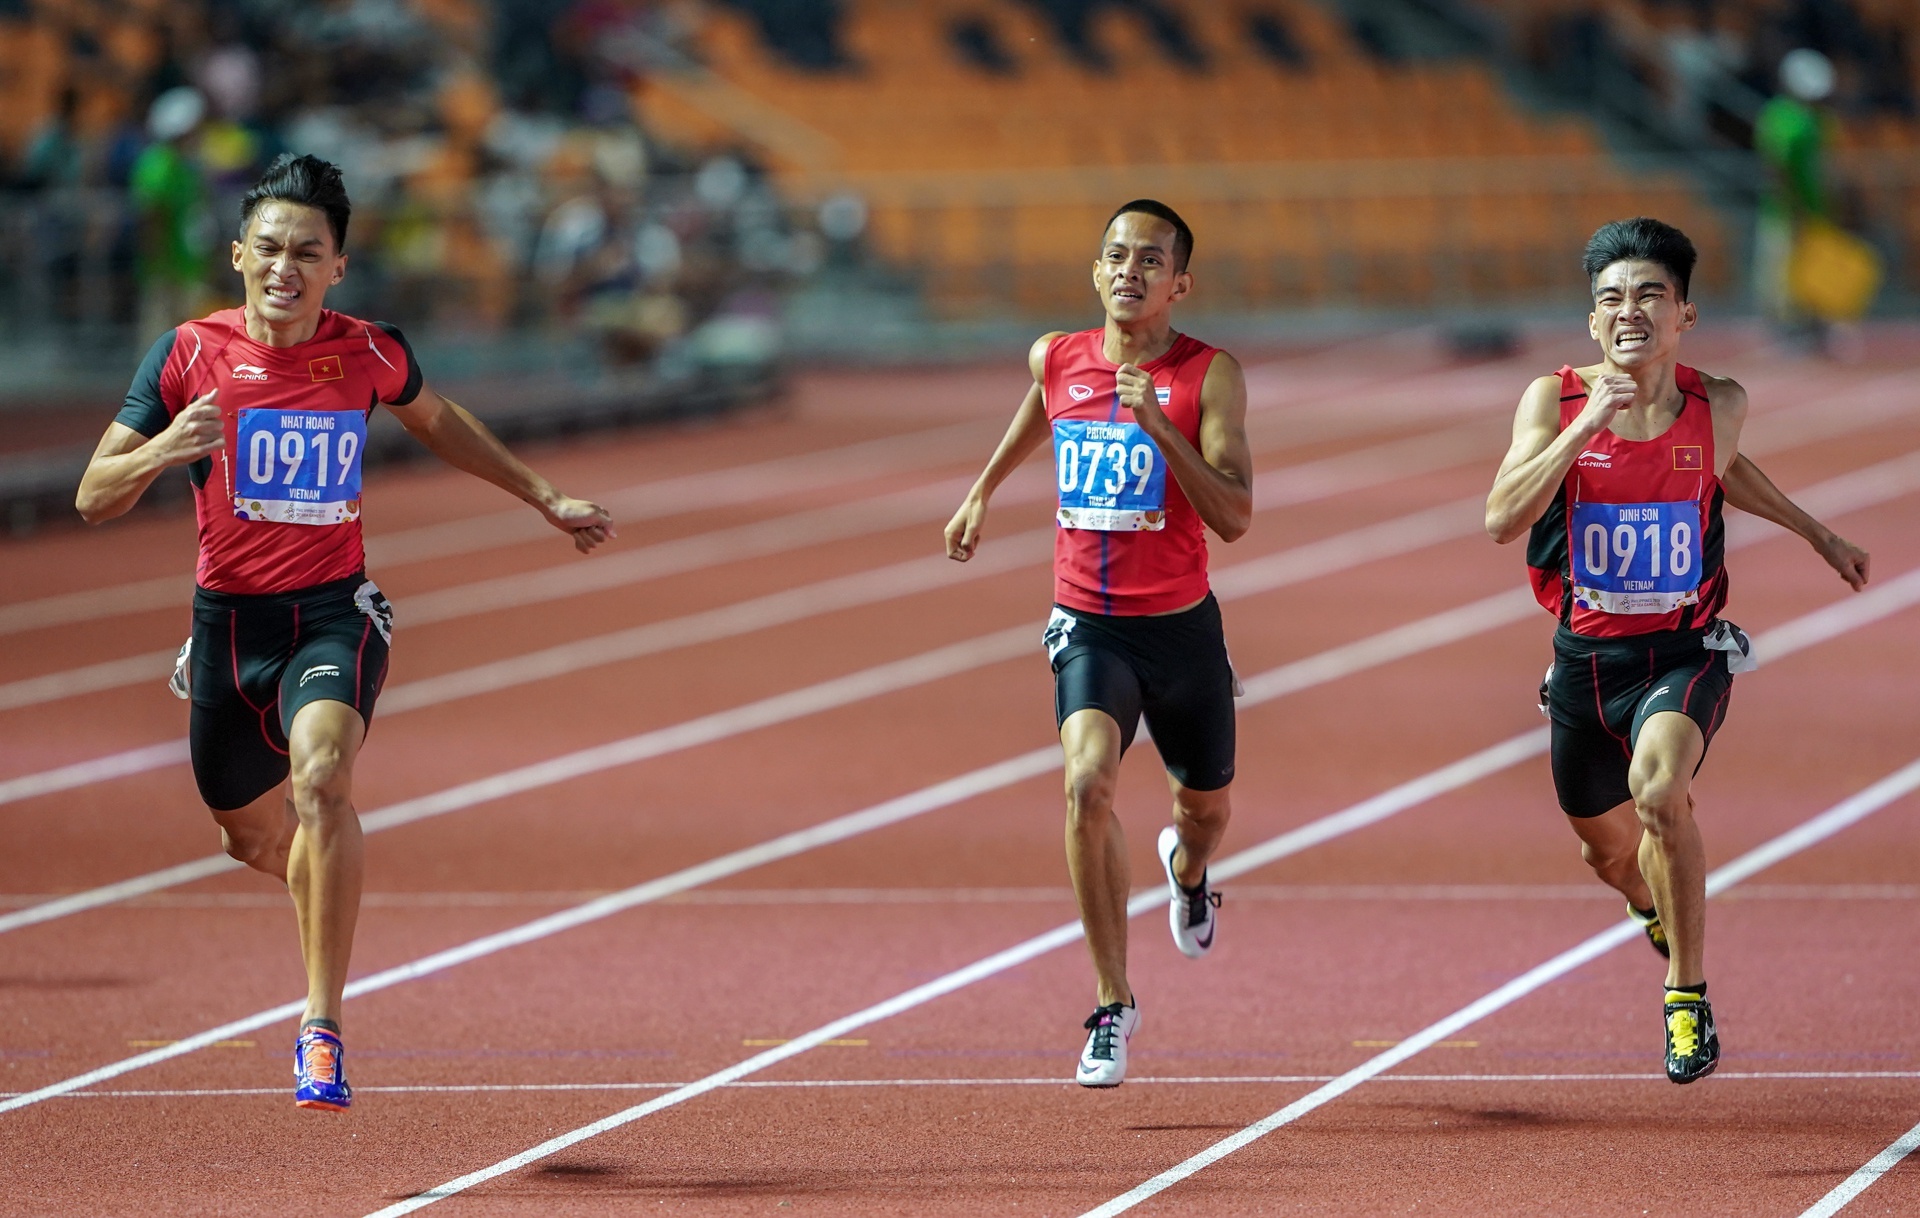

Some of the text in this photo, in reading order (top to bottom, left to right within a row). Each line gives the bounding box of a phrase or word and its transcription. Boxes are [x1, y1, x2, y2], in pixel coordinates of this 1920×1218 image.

[232, 373, 269, 381] LI-NING
[281, 415, 335, 430] NHAT HOANG
[249, 430, 358, 487] 0919
[1578, 460, 1612, 468] LI-NING
[1059, 440, 1154, 495] 0739
[289, 488, 320, 500] VIETNAM
[1620, 508, 1659, 522] DINH SON
[1584, 522, 1691, 577] 0918
[1623, 580, 1654, 591] VIETNAM
